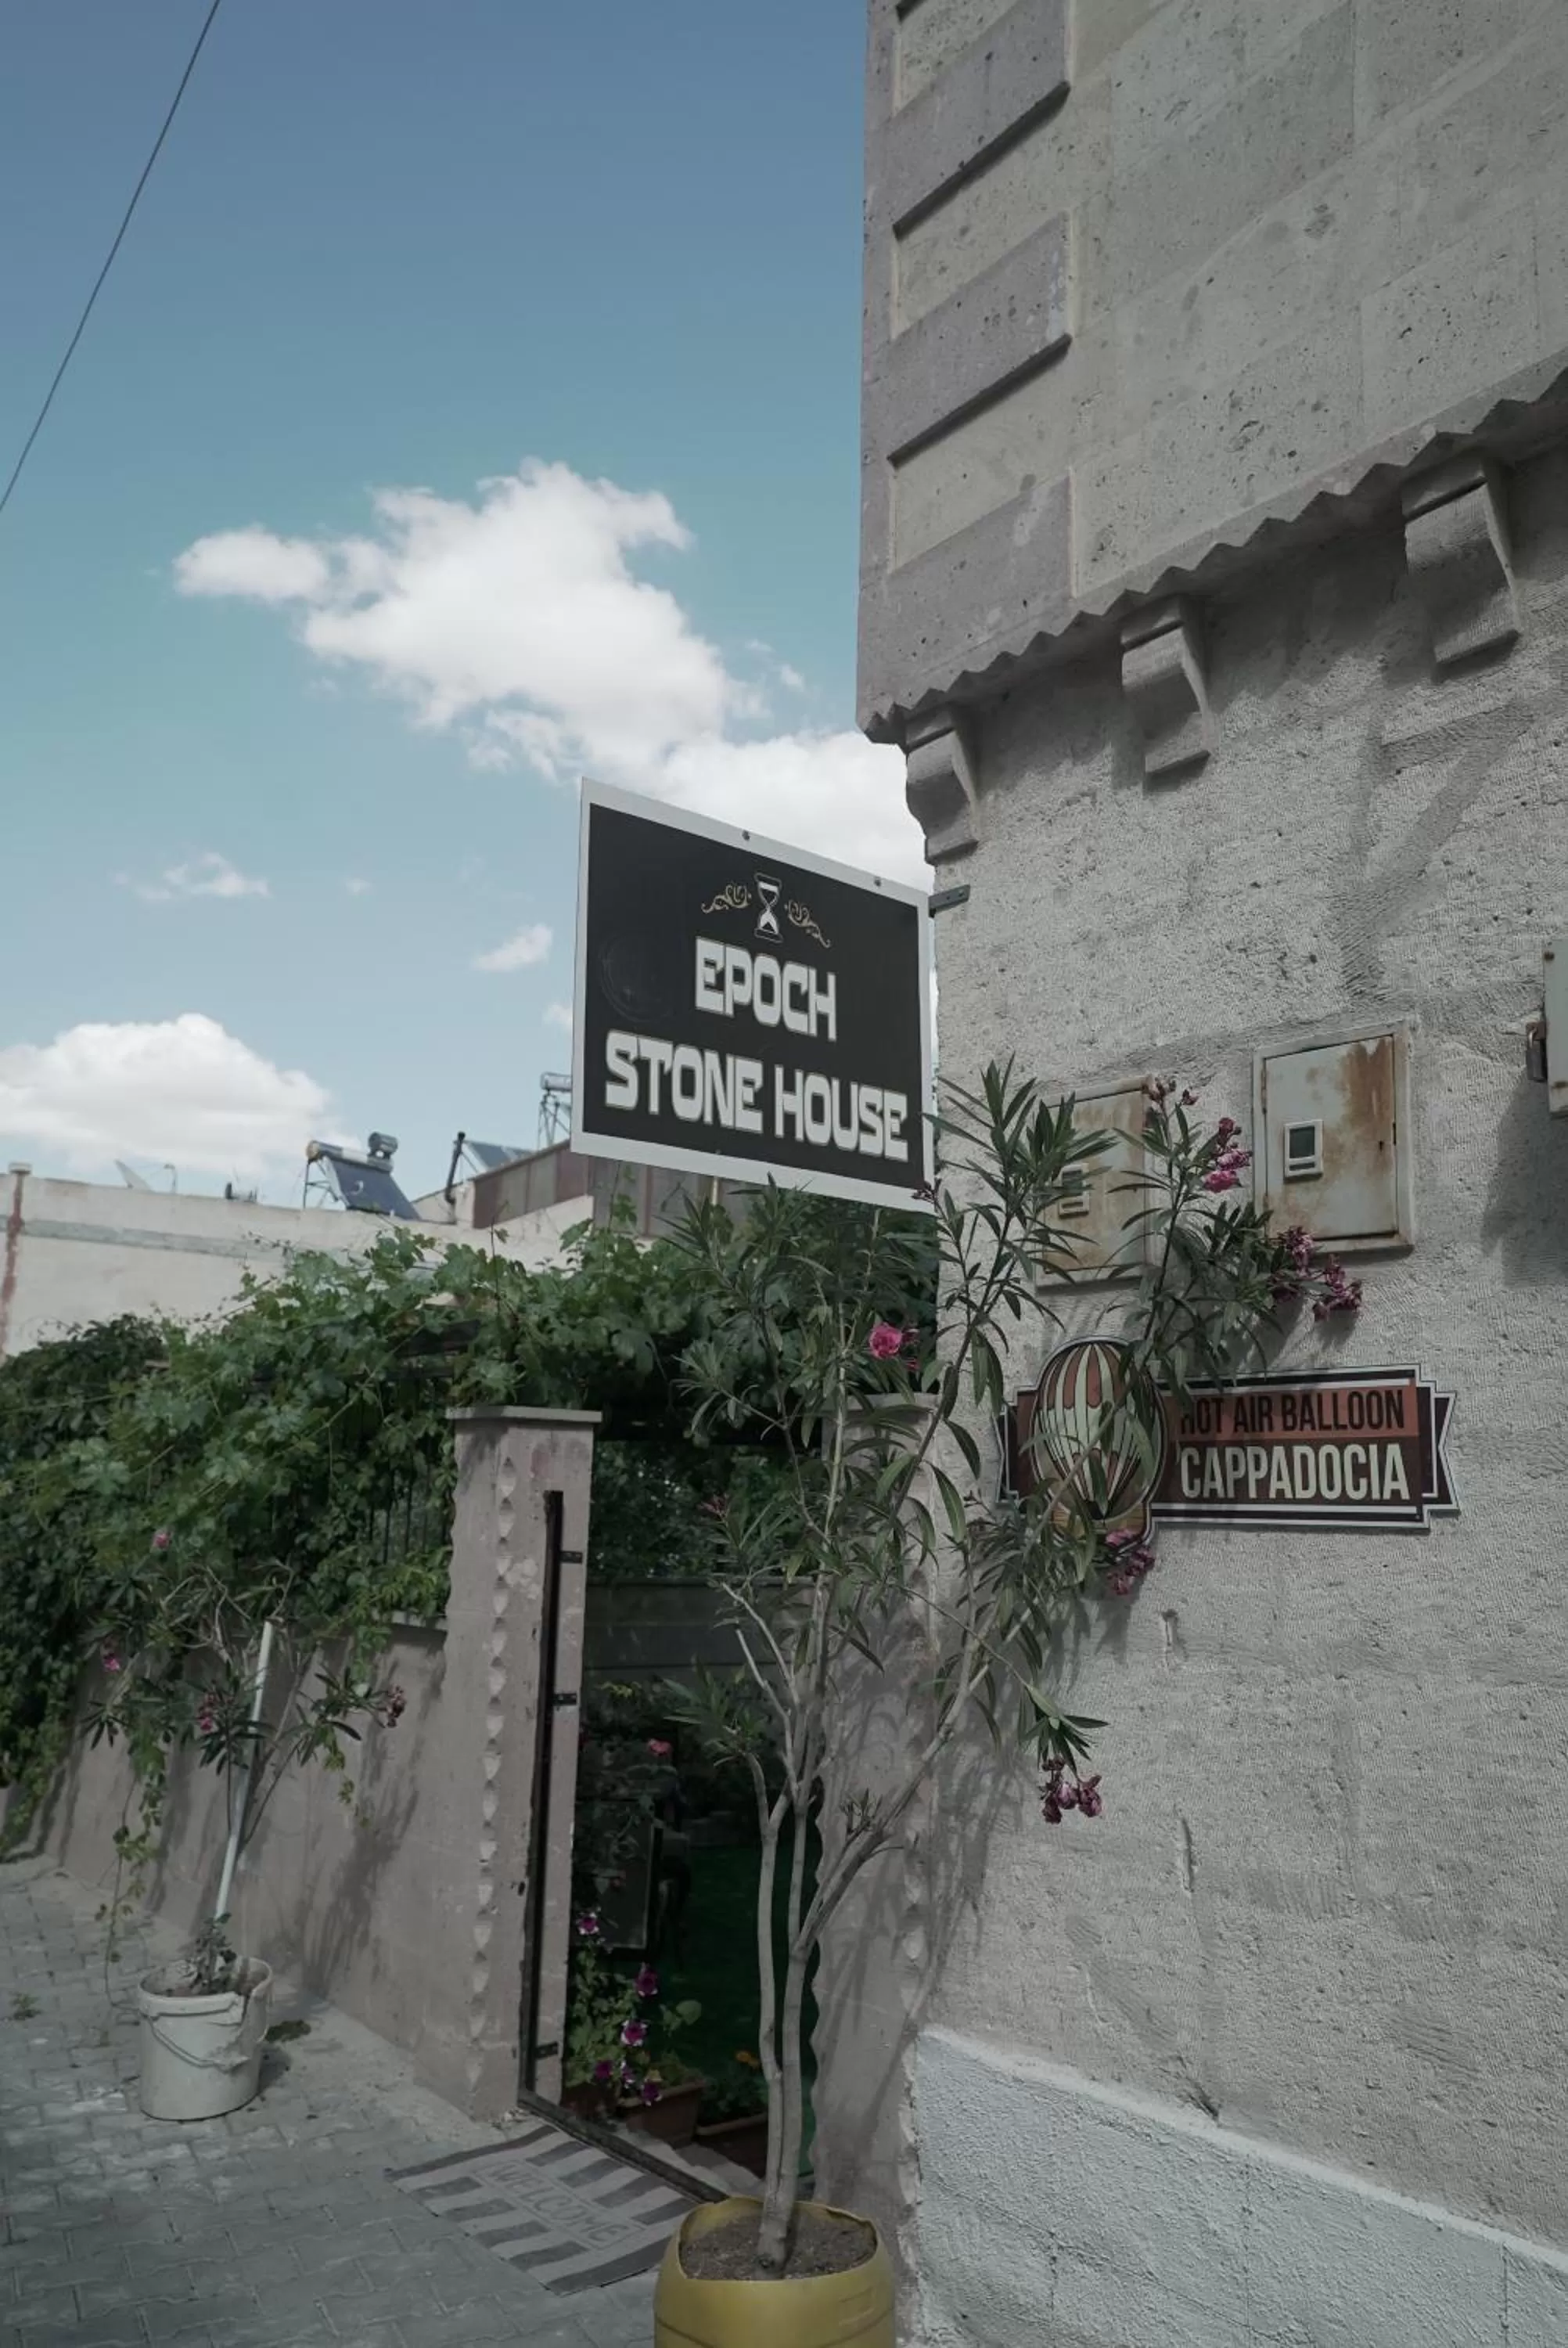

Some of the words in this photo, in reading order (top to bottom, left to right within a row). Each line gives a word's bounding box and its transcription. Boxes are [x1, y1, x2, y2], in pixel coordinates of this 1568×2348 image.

[695, 936, 836, 1042] EPOCH
[605, 1030, 764, 1134] STONE
[775, 1064, 908, 1162] HOUSE
[1233, 1395, 1273, 1433] AIR
[1282, 1389, 1404, 1431] BALLOON
[1181, 1443, 1411, 1500] CAPPADOCIA
[488, 2162, 631, 2241] WELCOME
